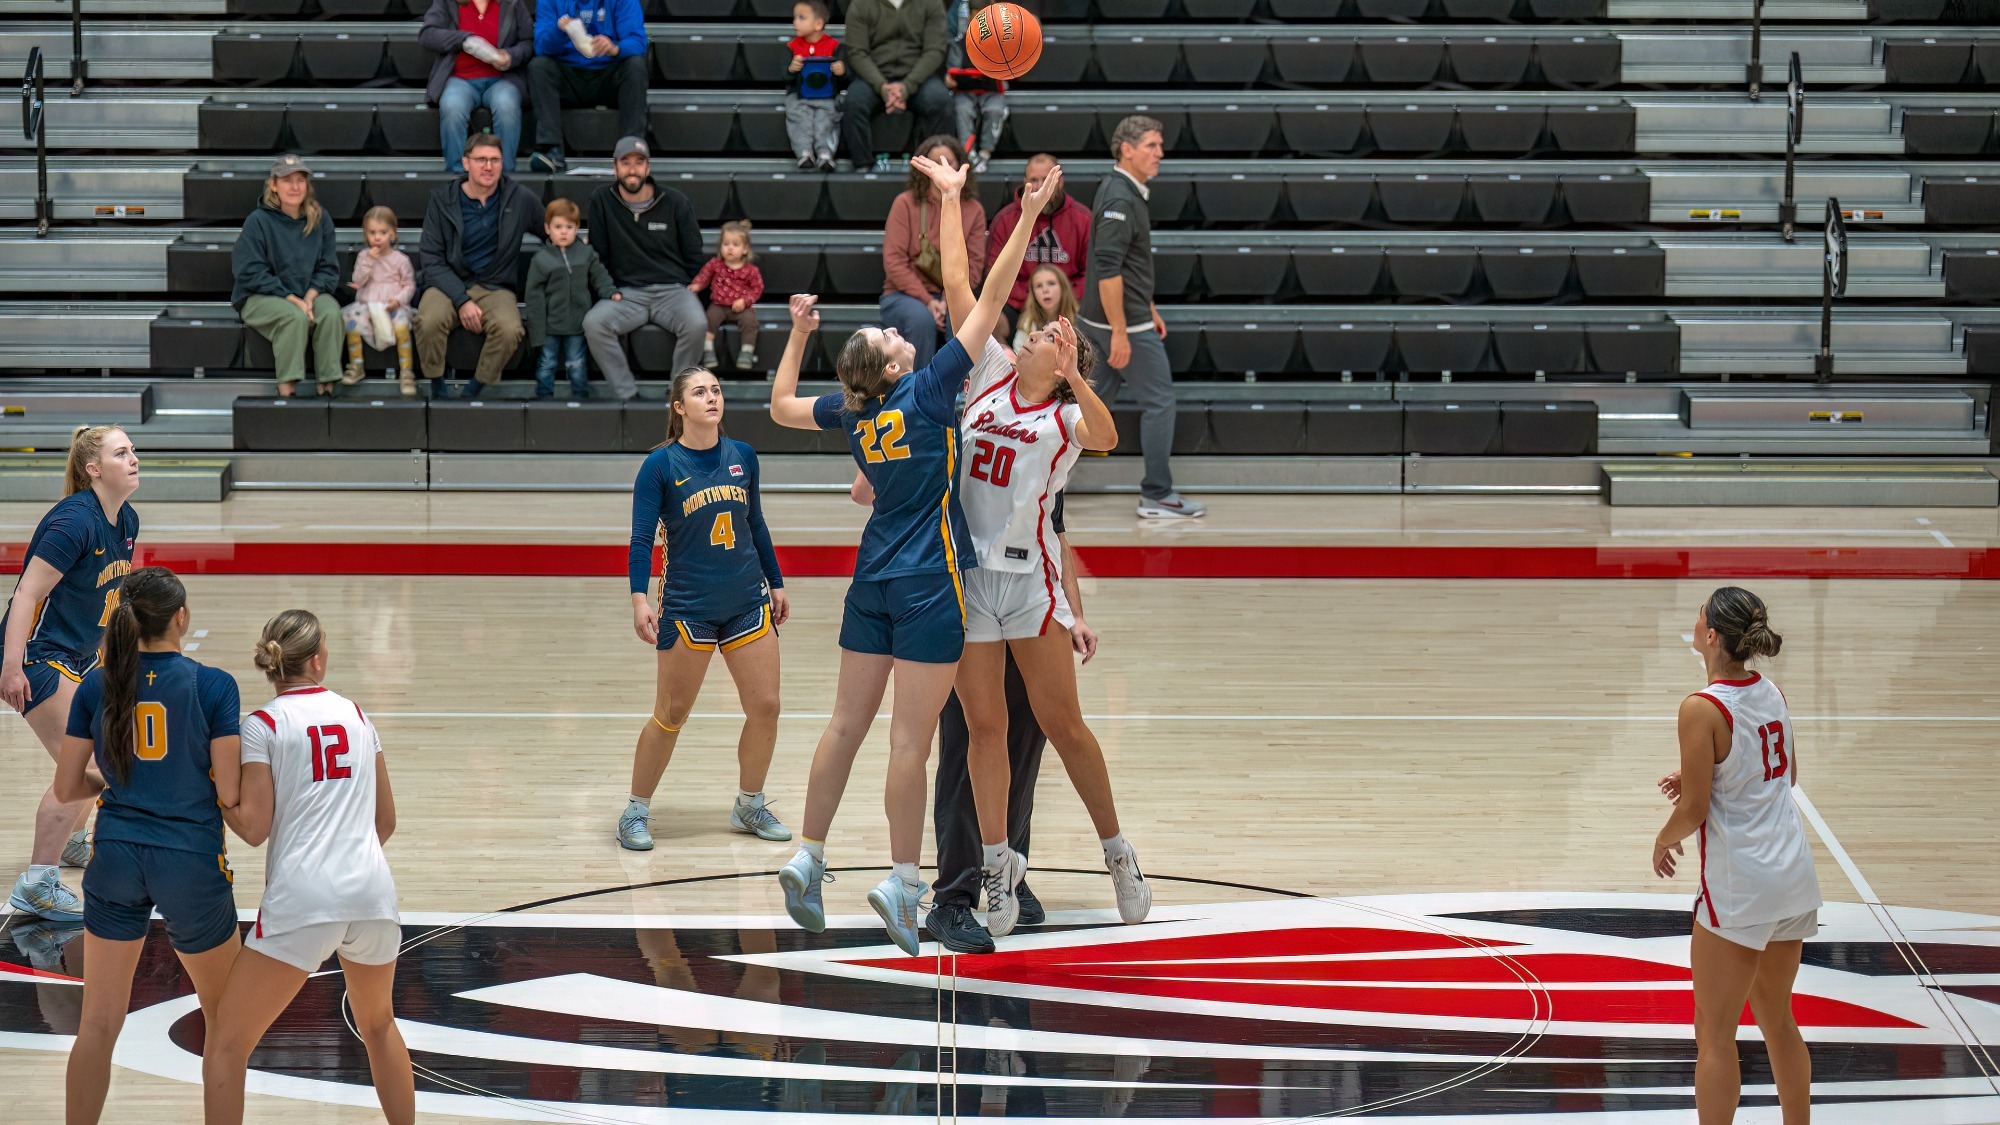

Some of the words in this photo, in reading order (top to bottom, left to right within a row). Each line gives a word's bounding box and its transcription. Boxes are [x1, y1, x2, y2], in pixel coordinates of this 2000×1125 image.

[999, 3, 1014, 41] ALDING
[853, 409, 911, 463] 22
[970, 439, 1016, 487] 20
[682, 485, 747, 517] NORTHWEST
[710, 511, 735, 550] 4
[96, 560, 131, 589] NORTHWE
[132, 701, 168, 760] 0
[307, 724, 351, 782] 12
[1758, 720, 1788, 782] 13
